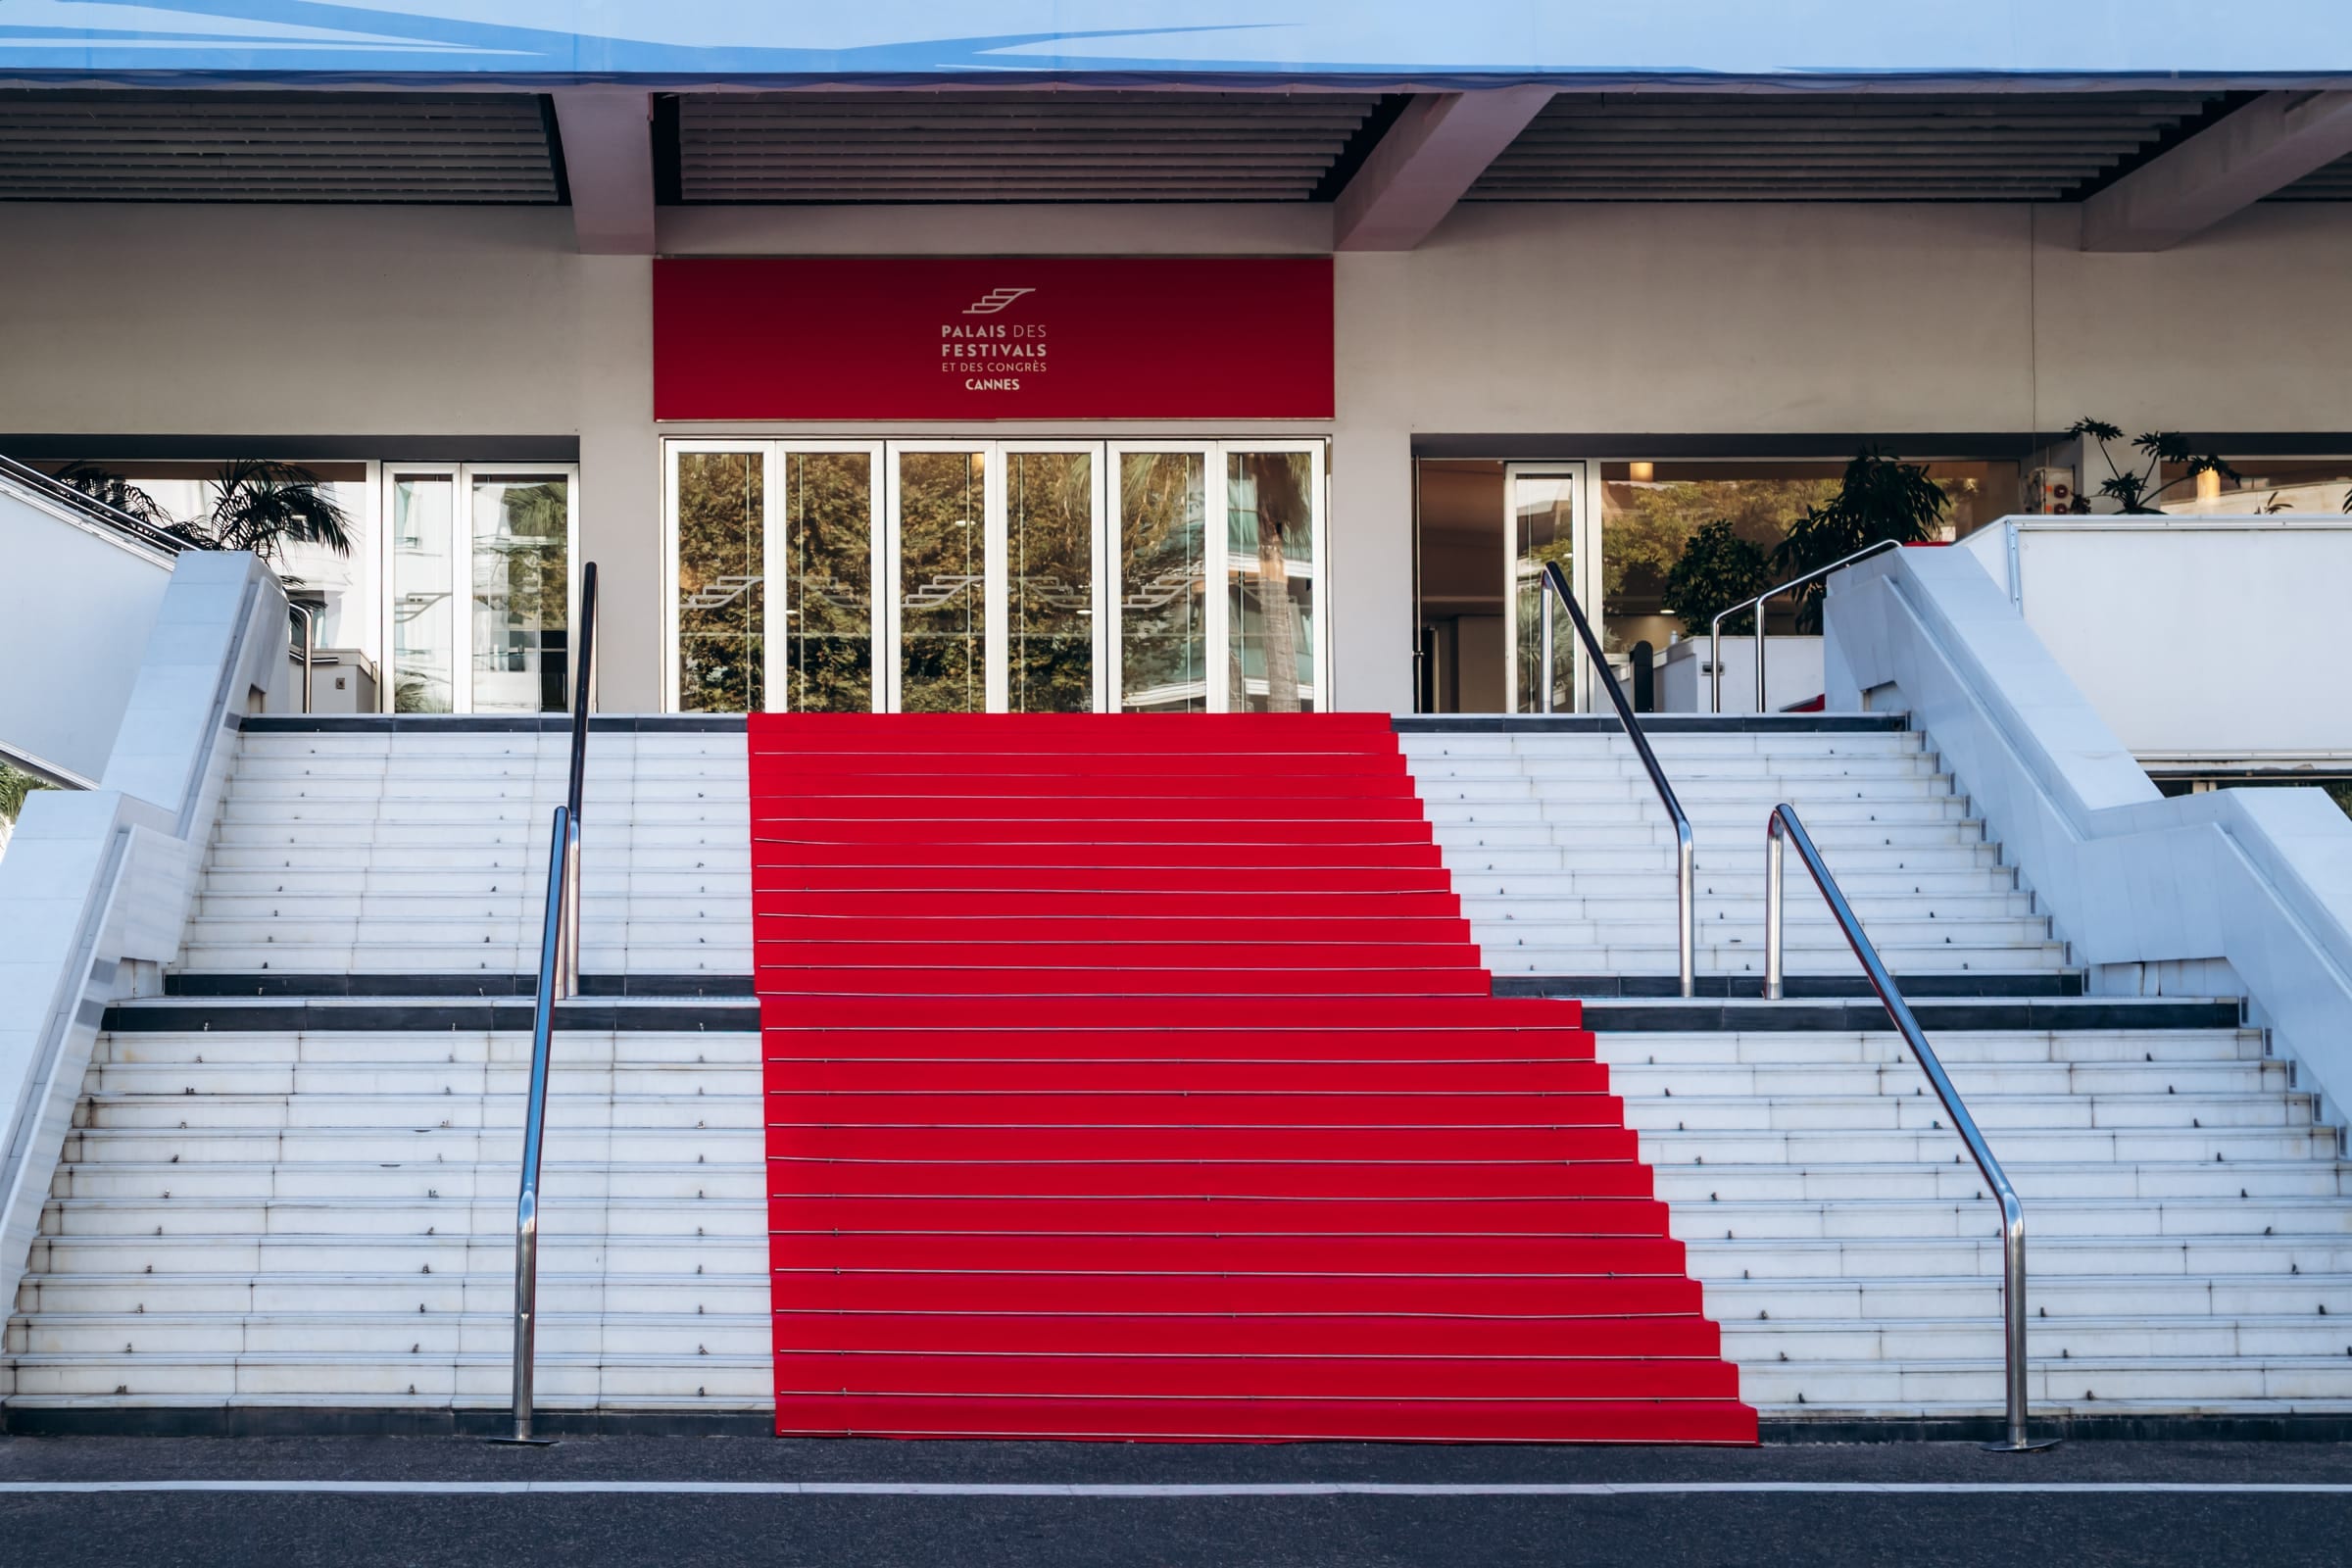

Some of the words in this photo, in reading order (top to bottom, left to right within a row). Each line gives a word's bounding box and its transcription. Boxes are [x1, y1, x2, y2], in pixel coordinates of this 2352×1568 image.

[941, 324, 1006, 338] PALAIS
[1013, 324, 1047, 338] DES
[941, 343, 1047, 358] FESTIVALS
[942, 362, 956, 372] ET
[959, 362, 984, 372] DES
[987, 360, 1047, 372] CONGRÈS
[964, 378, 1020, 391] CANNES
